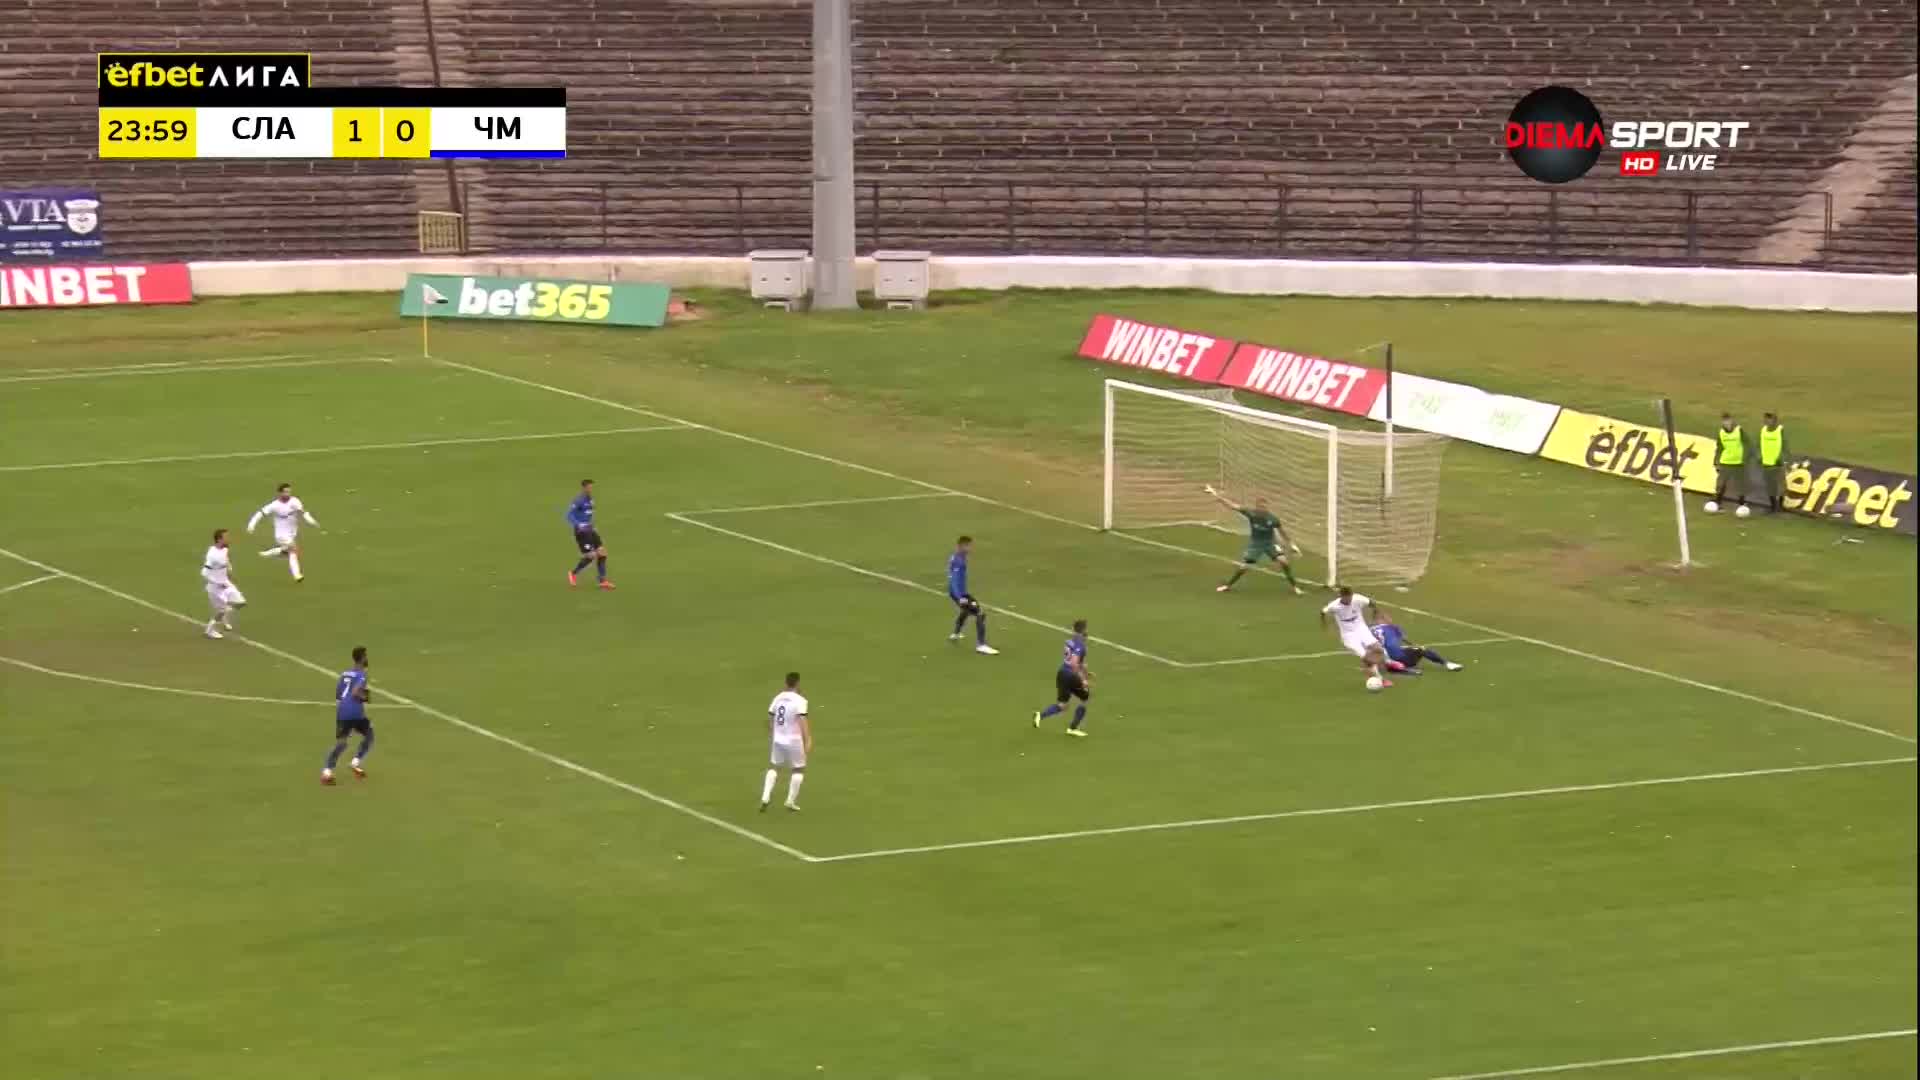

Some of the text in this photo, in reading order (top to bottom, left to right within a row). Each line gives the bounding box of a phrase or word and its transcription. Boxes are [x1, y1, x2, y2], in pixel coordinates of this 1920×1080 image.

[458, 277, 613, 320] bet365
[1102, 319, 1216, 377] WINBET
[1245, 348, 1368, 408] WINBET
[341, 677, 352, 698] 7
[777, 705, 786, 726] 8
